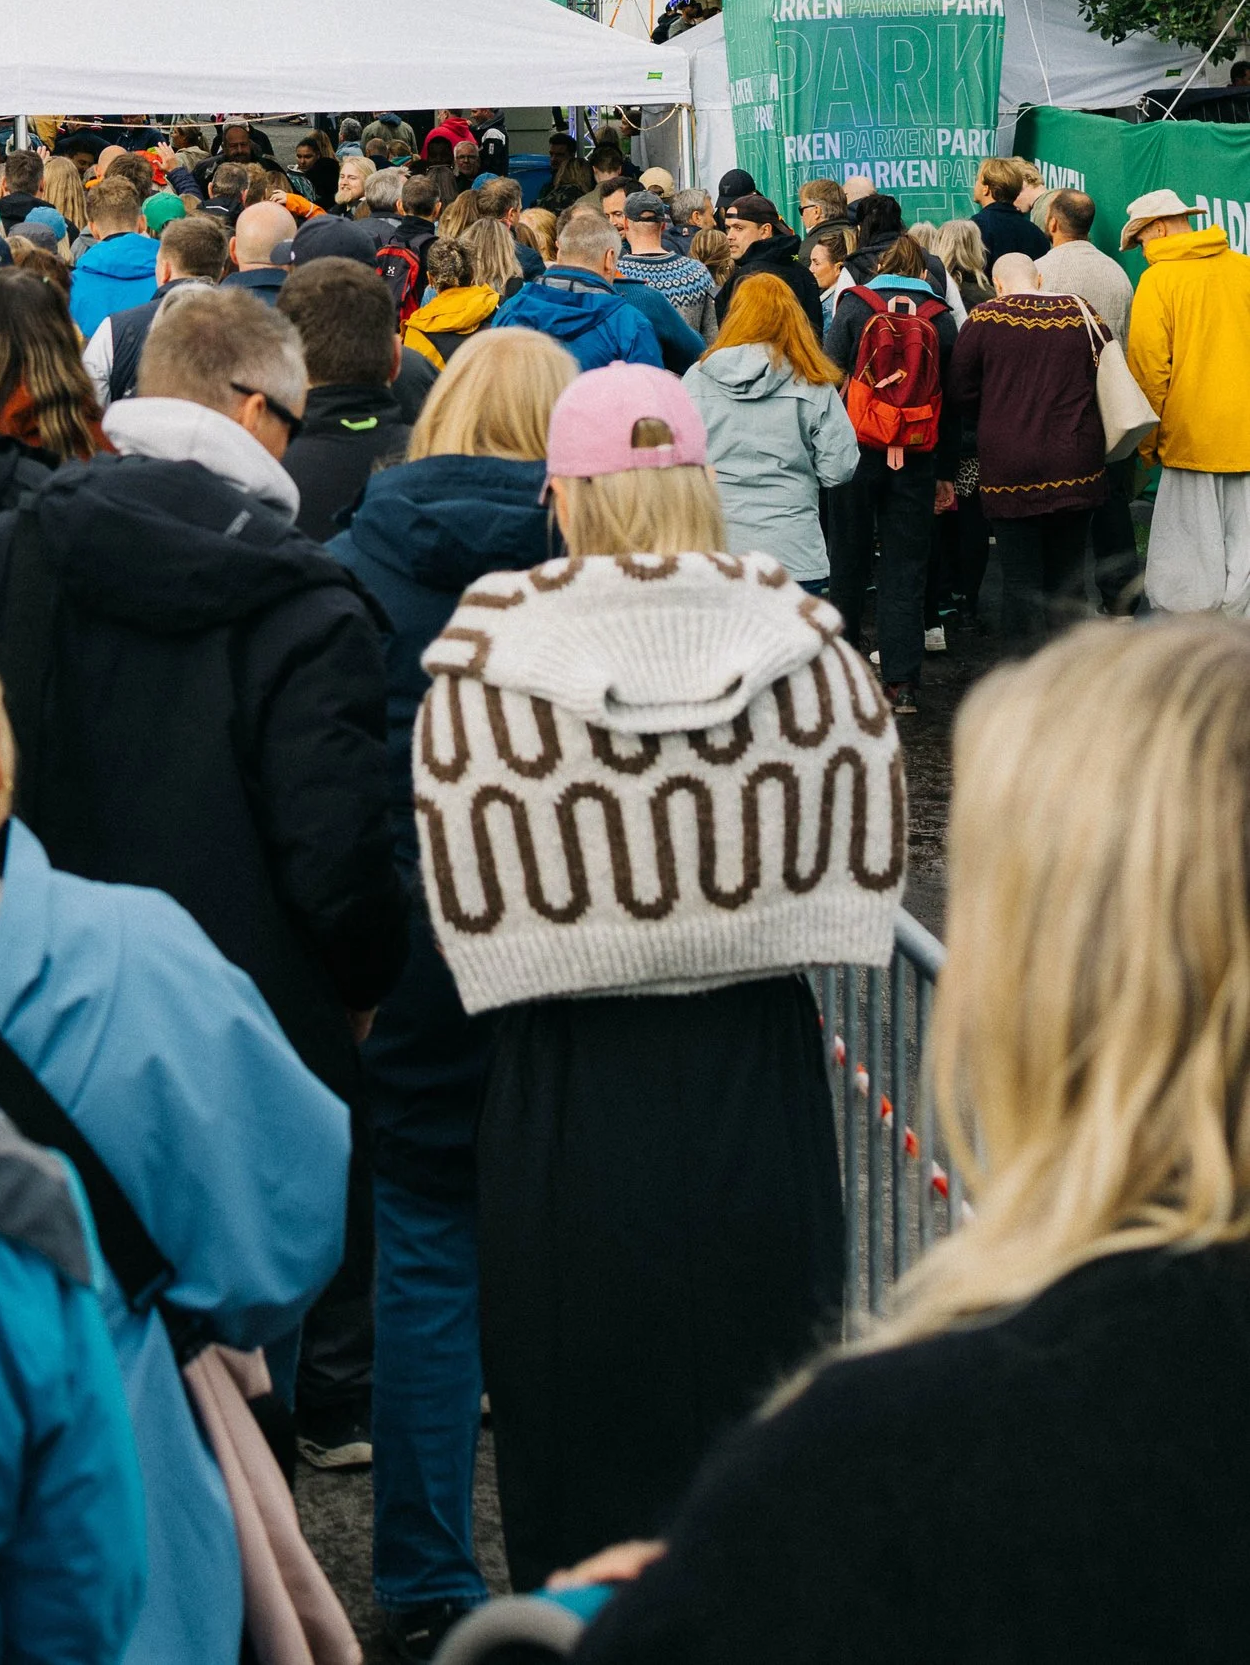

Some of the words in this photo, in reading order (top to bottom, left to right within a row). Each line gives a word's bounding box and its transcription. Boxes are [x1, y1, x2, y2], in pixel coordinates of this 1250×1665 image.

[775, 23, 1002, 131] PARK
[784, 132, 841, 165] RKEN
[841, 128, 936, 159] PARKEN
[937, 128, 997, 157] PARK
